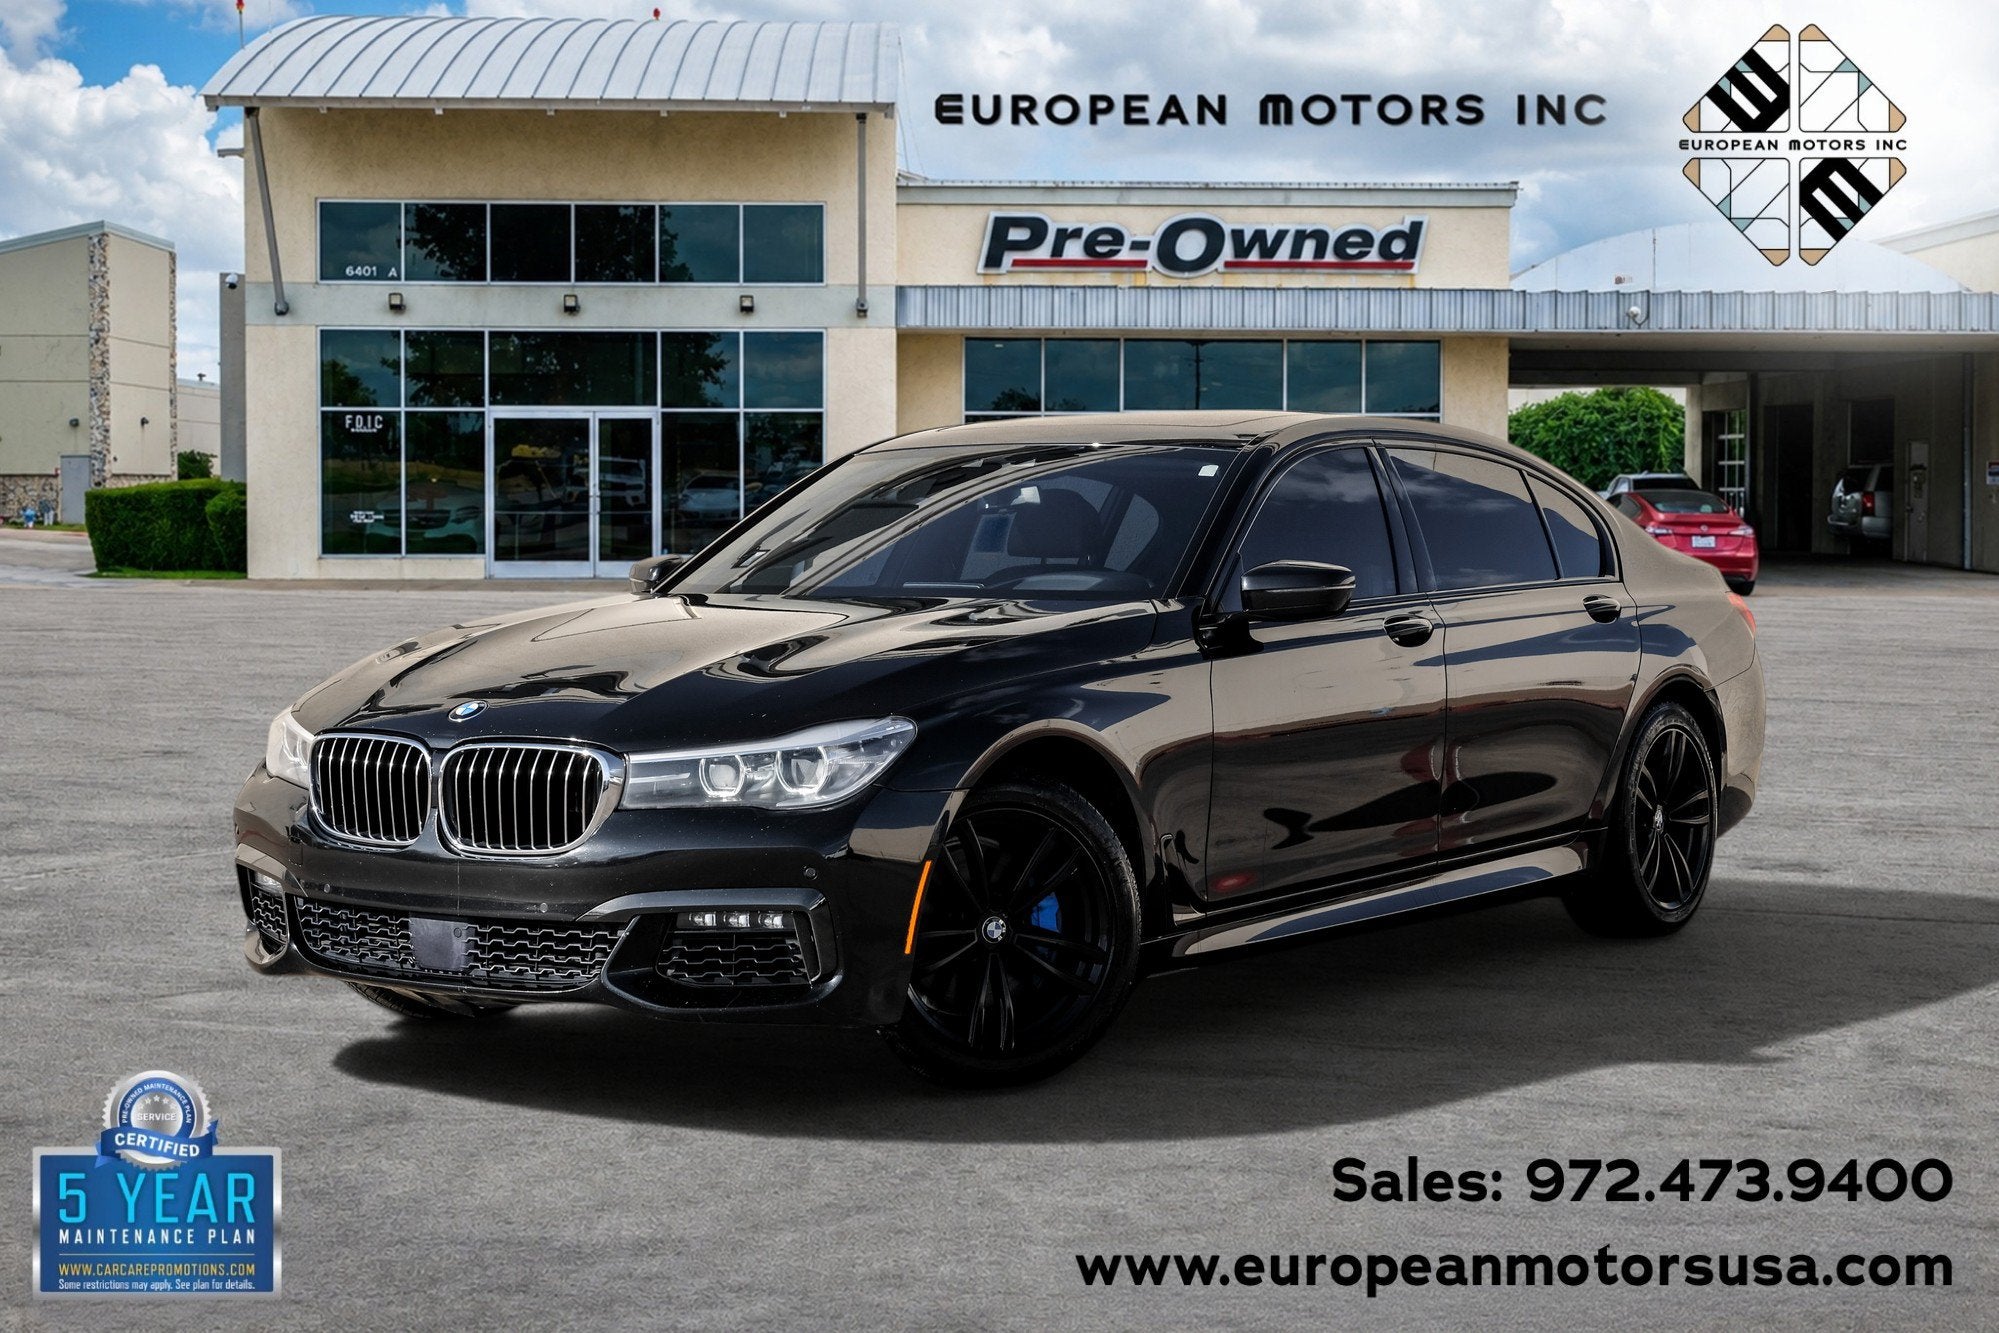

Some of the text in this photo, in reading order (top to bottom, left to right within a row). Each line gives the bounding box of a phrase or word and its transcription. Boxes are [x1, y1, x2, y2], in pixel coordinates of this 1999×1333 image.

[983, 215, 1424, 273] Pre-Owned
[345, 265, 398, 278] 6401 A
